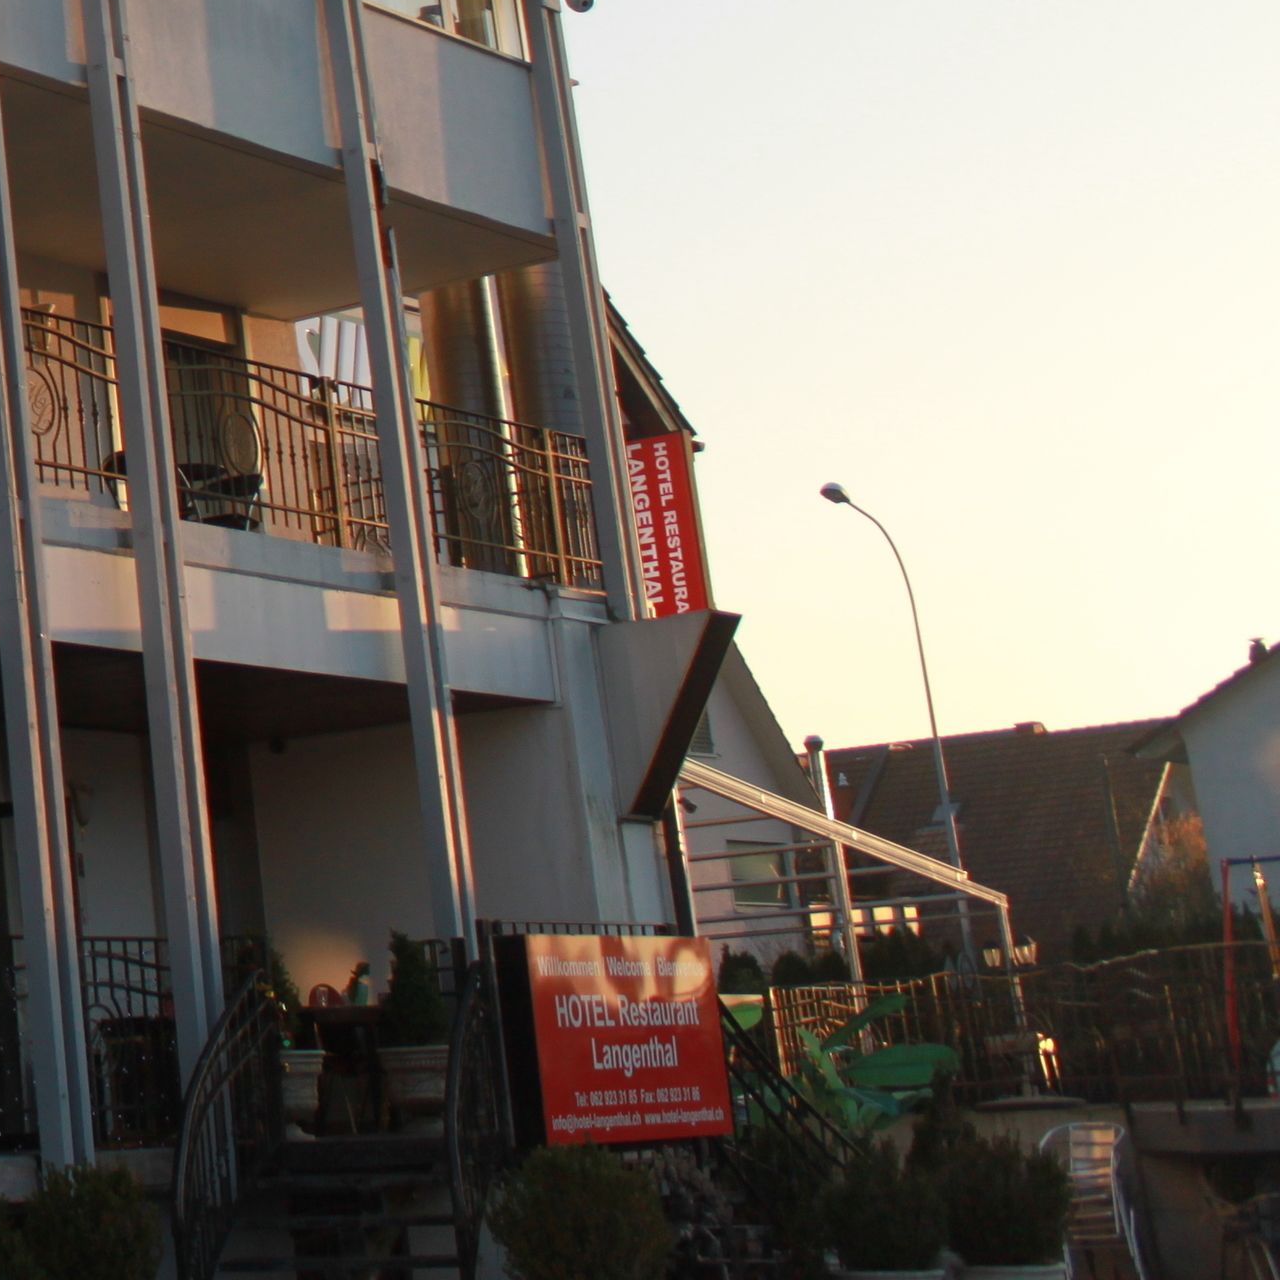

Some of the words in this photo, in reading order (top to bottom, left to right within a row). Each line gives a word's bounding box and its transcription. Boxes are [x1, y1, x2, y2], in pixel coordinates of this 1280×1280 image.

[653, 441, 673, 507] HOTEL
[538, 956, 600, 977] Willkommen
[607, 956, 651, 977] Welcome
[556, 995, 615, 1027] HOTEL
[619, 995, 700, 1026] Restaurant
[592, 1035, 678, 1077] Langenthal
